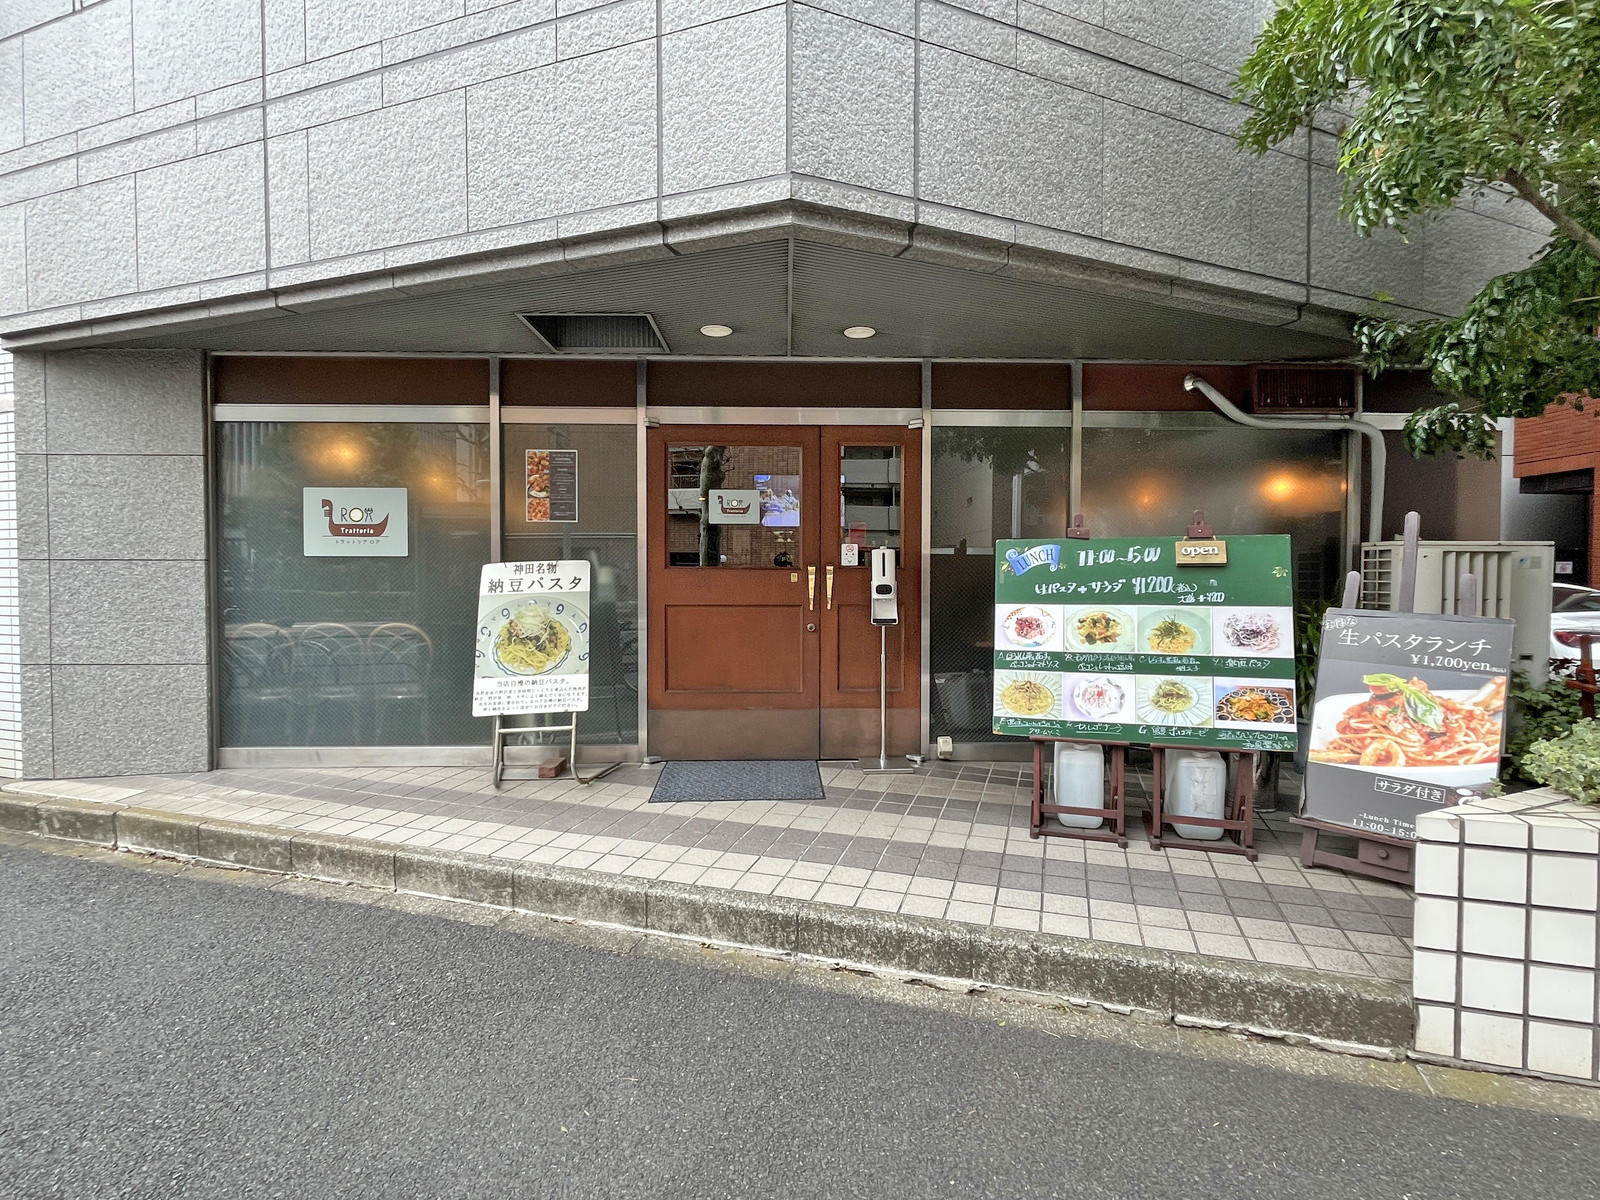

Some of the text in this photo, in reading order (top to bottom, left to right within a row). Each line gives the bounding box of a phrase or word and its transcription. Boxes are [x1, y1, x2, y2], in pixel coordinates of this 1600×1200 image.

[1016, 548, 1054, 570] LUNCH
[1181, 546, 1219, 557] open
[513, 562, 557, 575] 神田名物
[487, 576, 582, 593] 納豆パスタ
[1337, 628, 1492, 657] 生パスタランチ
[1378, 780, 1442, 801] サラダ付き
[1352, 818, 1417, 839] 11:00-15:0
[1393, 818, 1415, 829] Time
